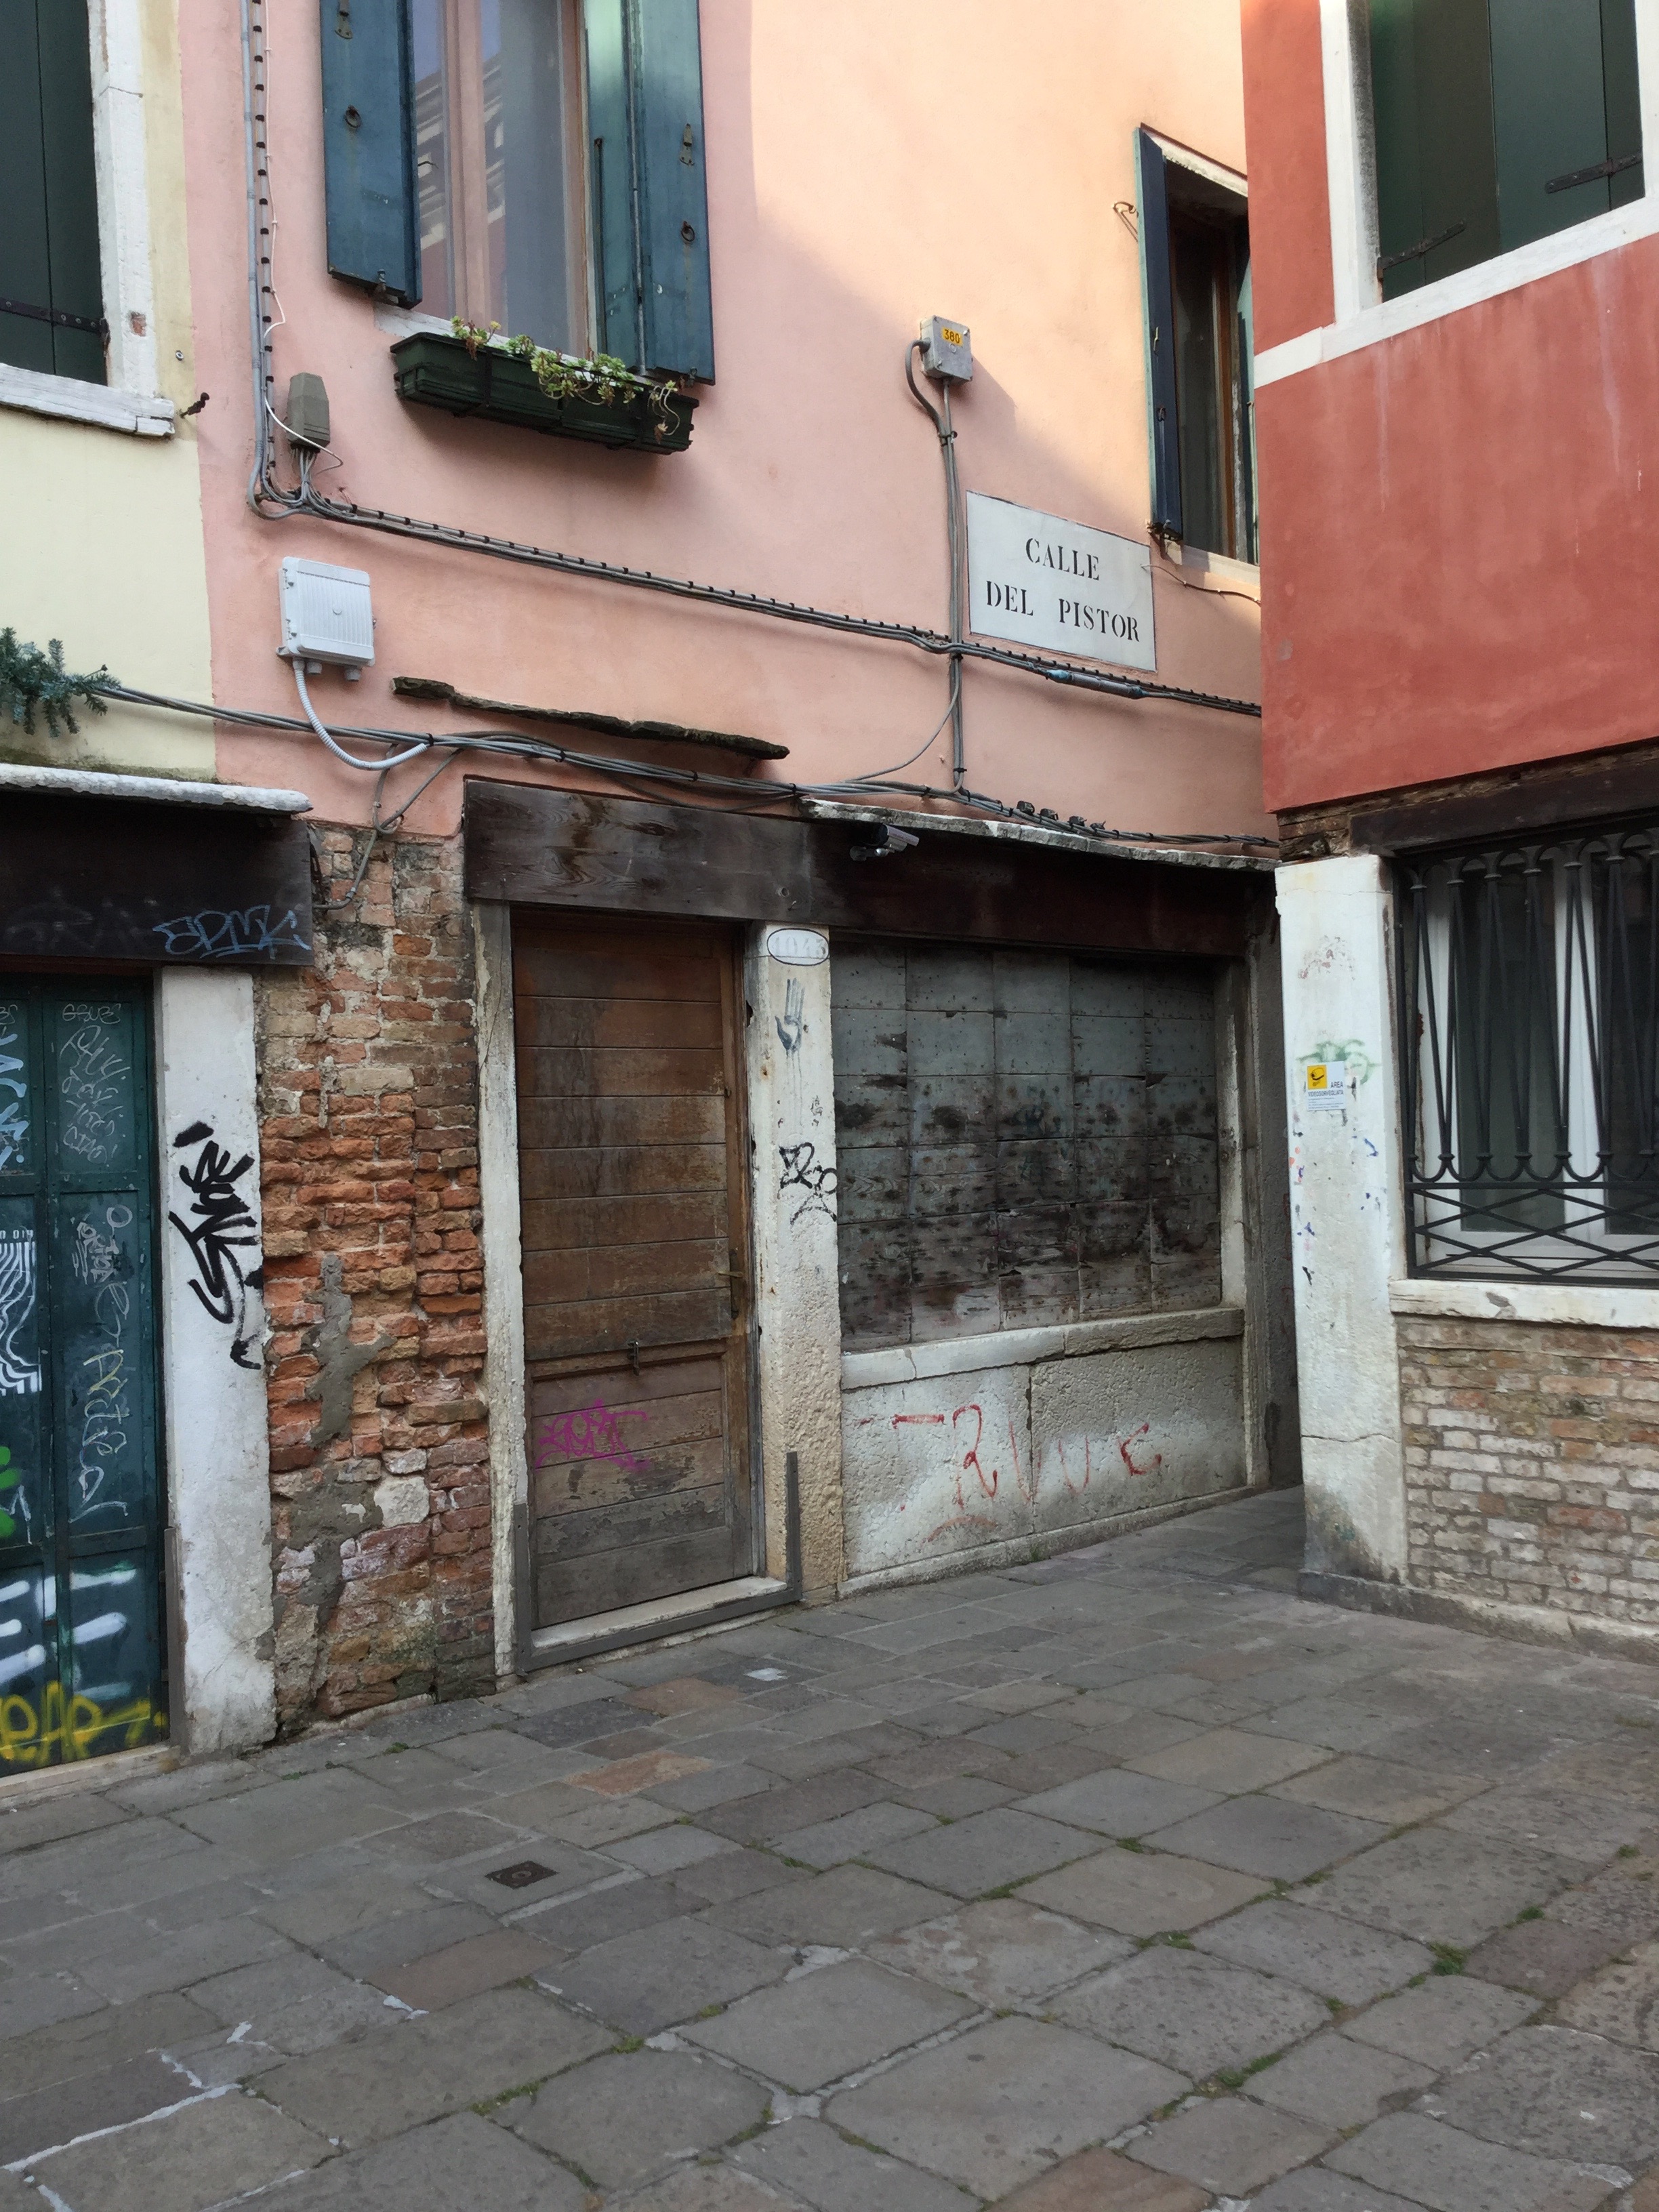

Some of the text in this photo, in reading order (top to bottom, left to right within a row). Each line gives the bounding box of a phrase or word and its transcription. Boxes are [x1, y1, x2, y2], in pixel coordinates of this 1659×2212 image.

[944, 329, 960, 344] 380
[1025, 537, 1100, 581] CALLE
[986, 580, 1140, 642] DEL PISTOR
